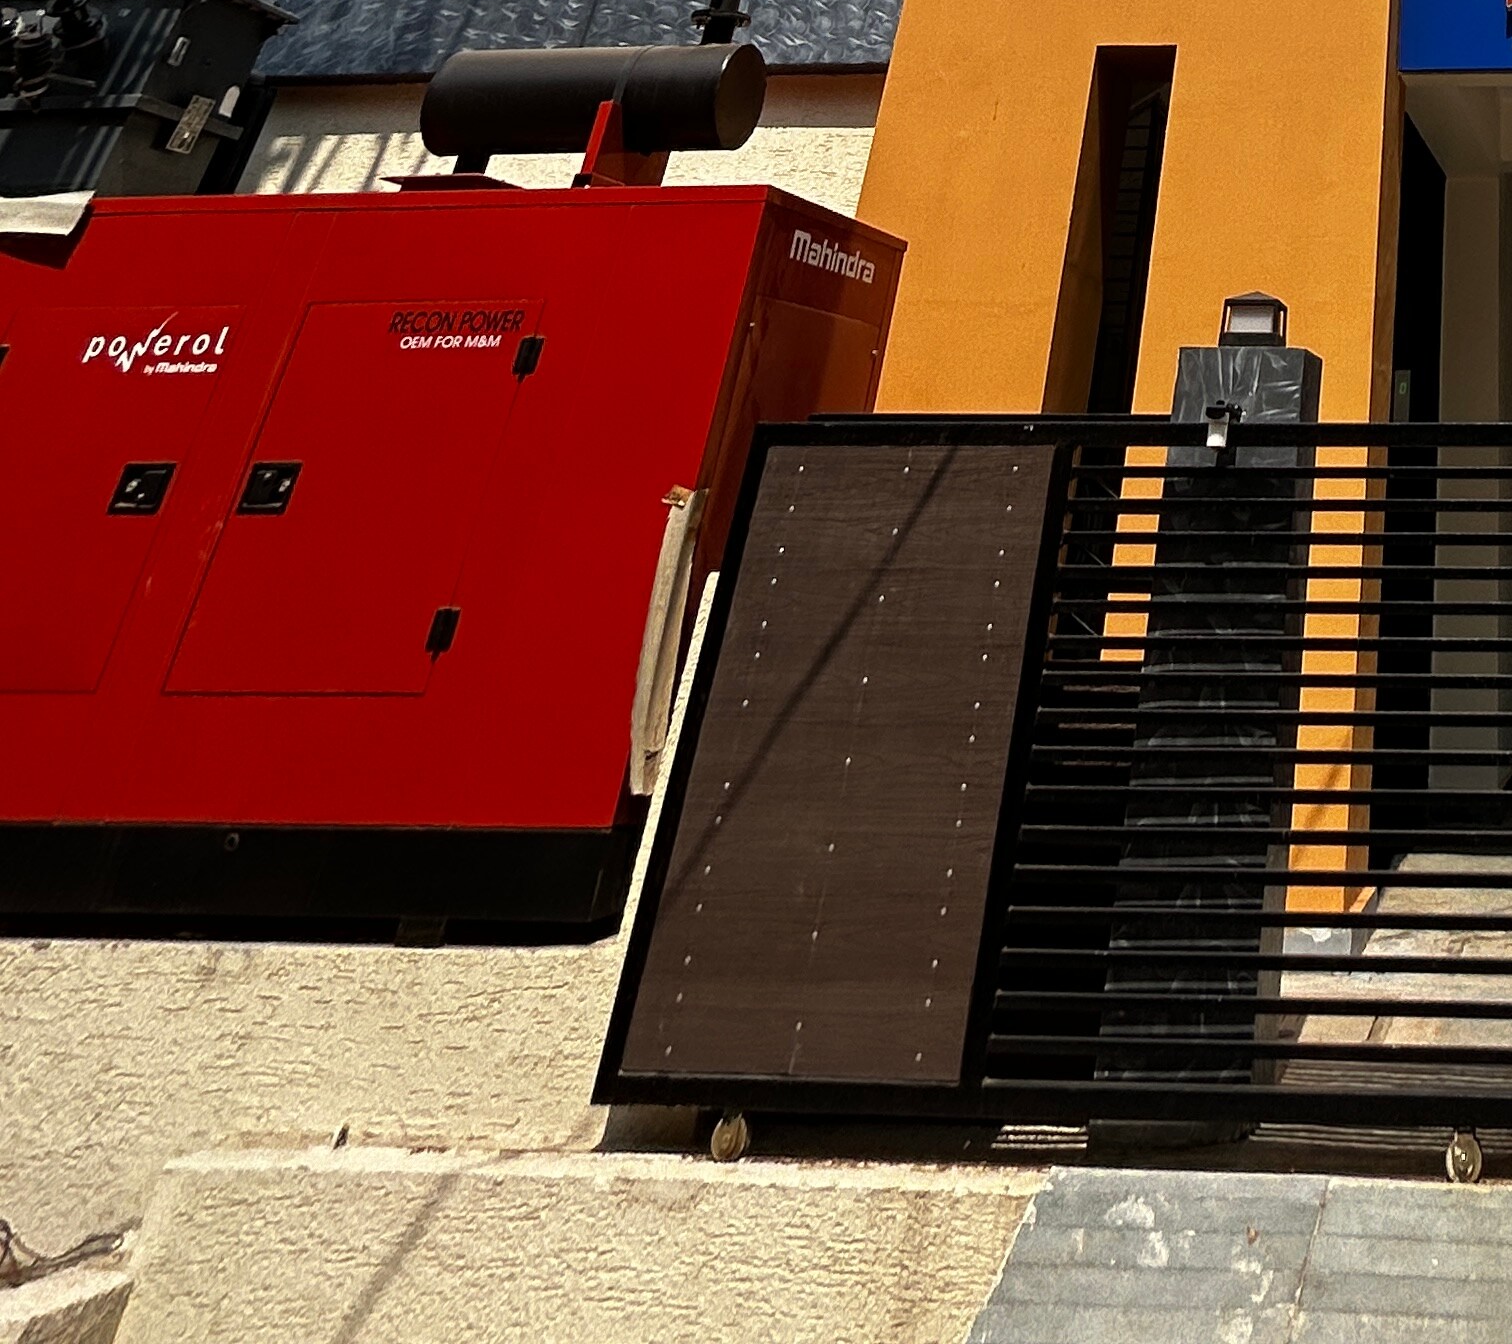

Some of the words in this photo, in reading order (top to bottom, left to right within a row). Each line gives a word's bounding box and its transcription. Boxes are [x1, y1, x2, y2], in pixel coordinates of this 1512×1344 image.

[789, 228, 876, 285] Mahindra
[389, 311, 457, 332] RECON
[459, 310, 525, 331] POWER
[400, 335, 434, 350] OEM
[433, 335, 464, 349] FOR
[464, 334, 503, 348] M&M
[155, 361, 218, 374] Mahindra
